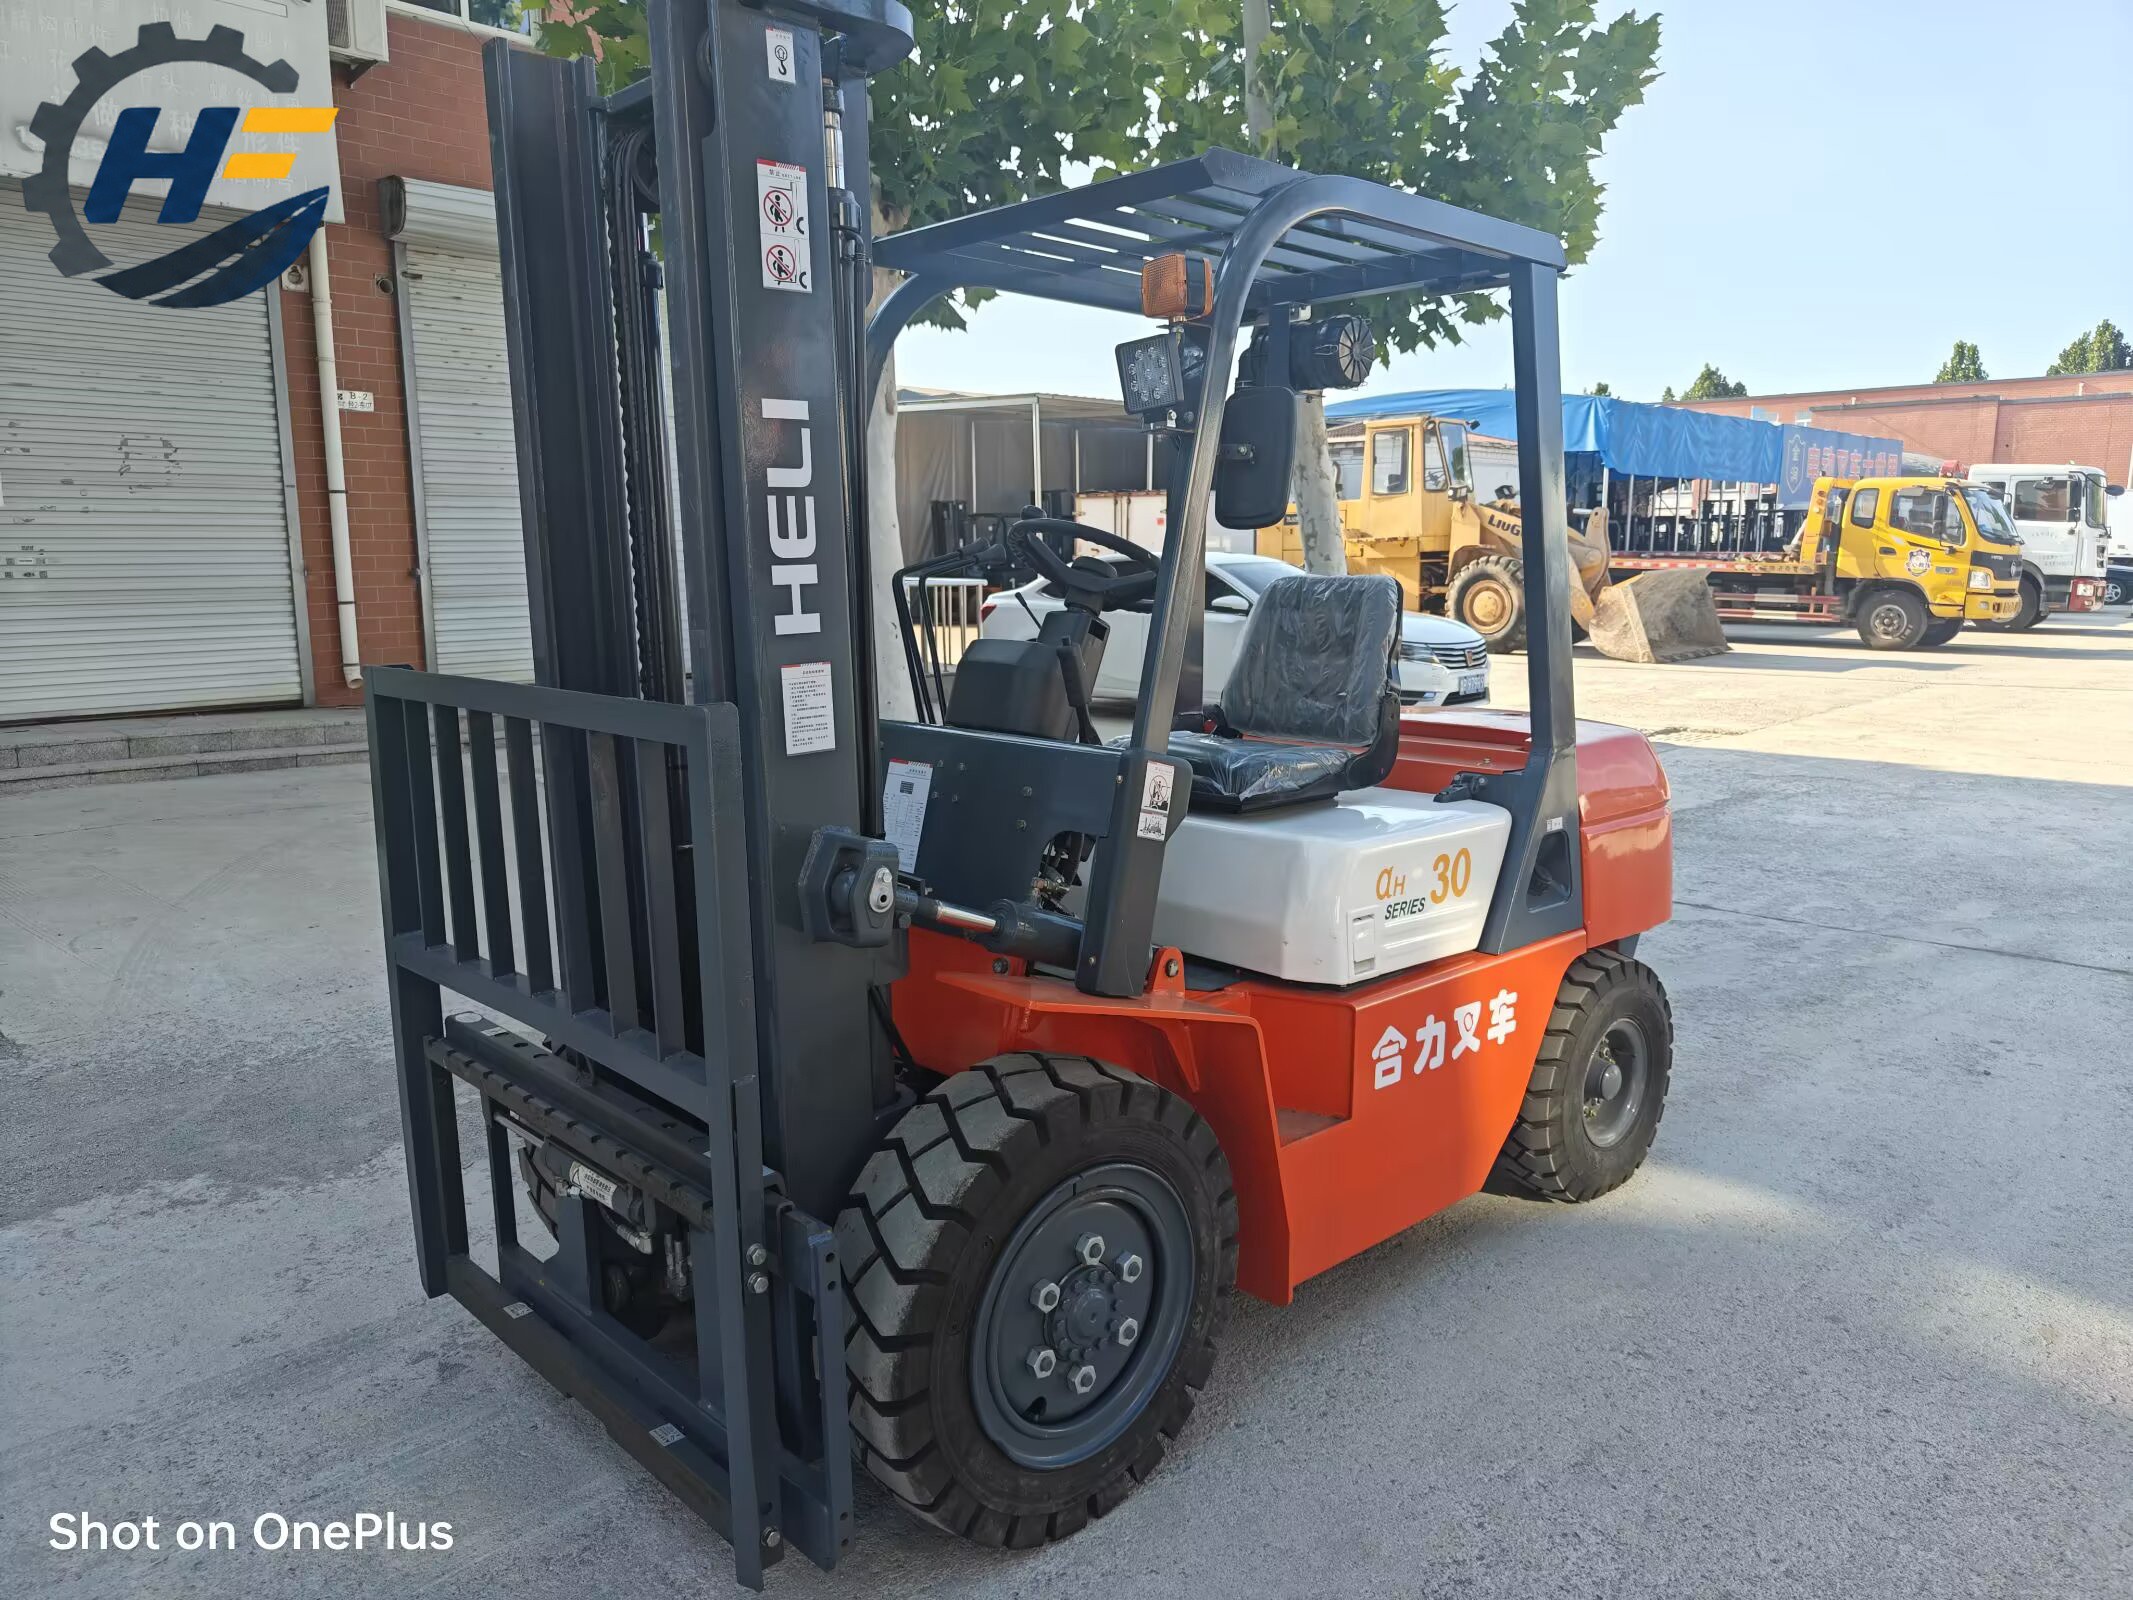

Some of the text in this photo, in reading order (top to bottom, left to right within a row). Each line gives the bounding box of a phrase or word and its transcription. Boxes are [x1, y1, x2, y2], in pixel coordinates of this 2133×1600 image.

[761, 398, 821, 636] HELI
[1384, 897, 1426, 920] SERIES
[1430, 847, 1472, 905] 30
[1371, 988, 1518, 1091] 合力叉车
